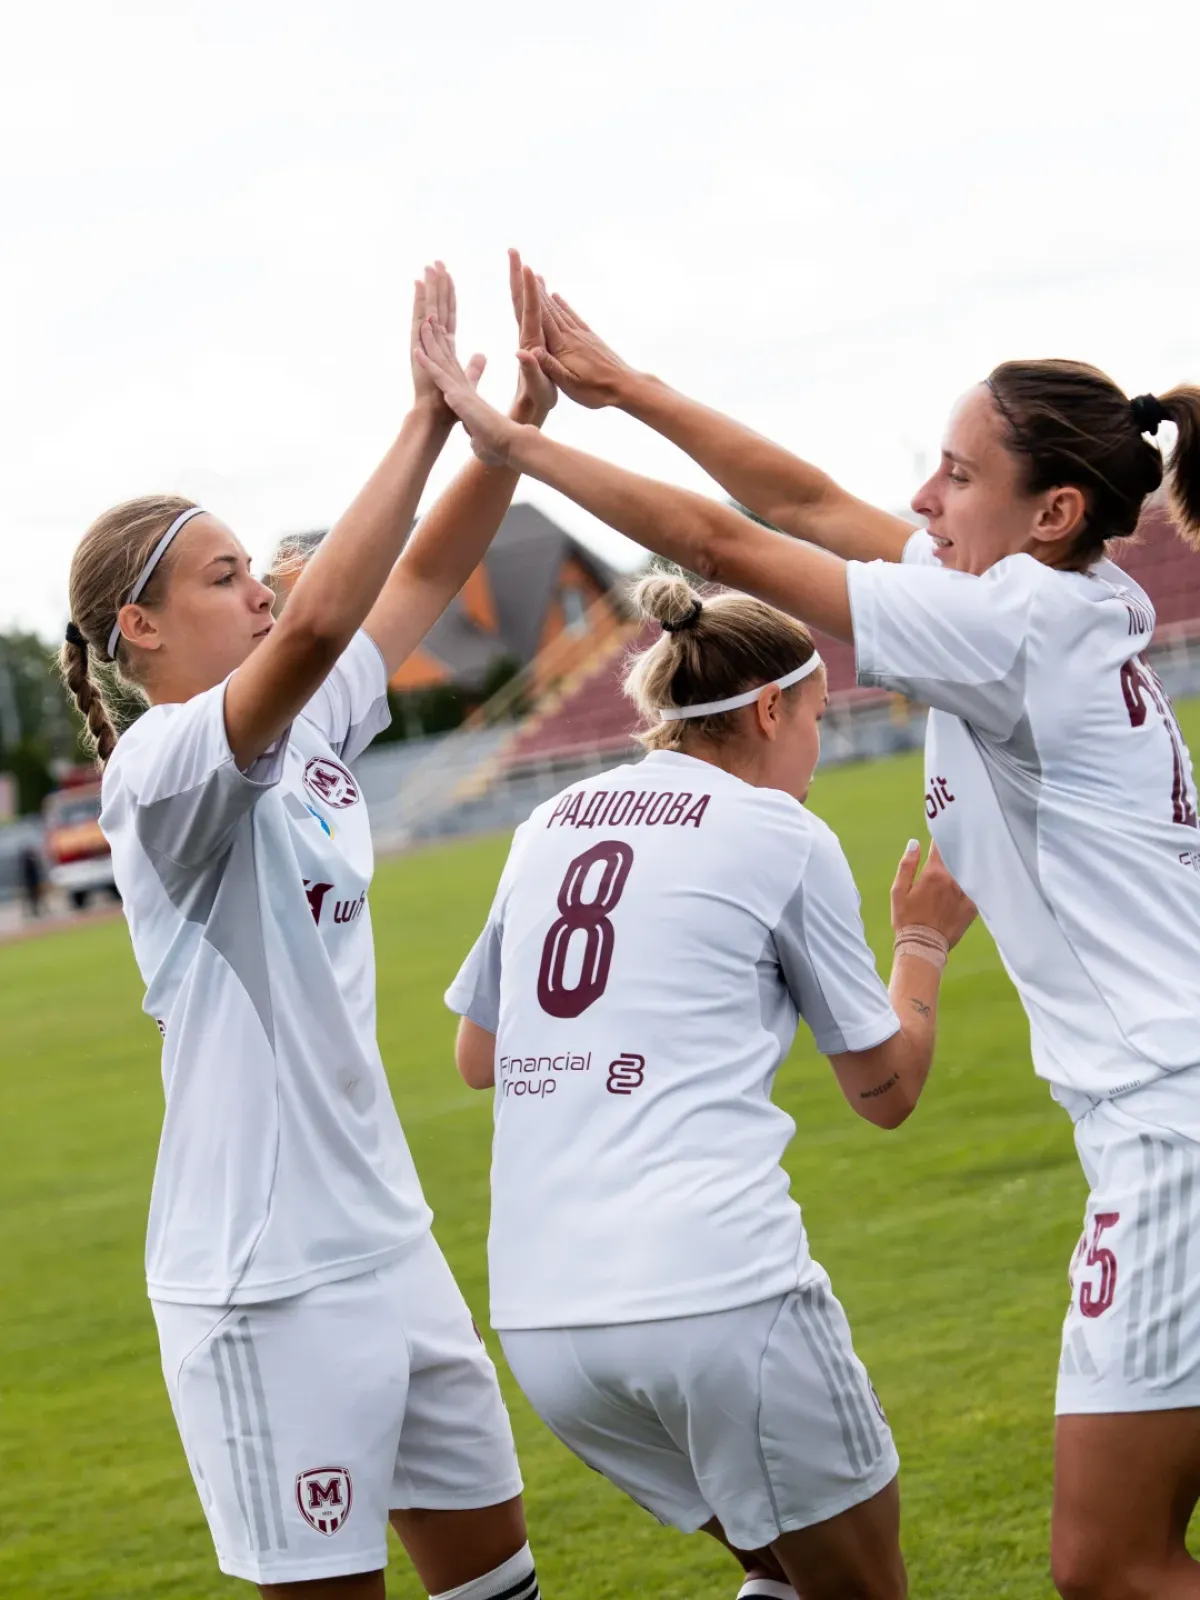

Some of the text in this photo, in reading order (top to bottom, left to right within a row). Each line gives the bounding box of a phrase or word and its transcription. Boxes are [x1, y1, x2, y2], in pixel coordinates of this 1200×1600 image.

[309, 767, 340, 798] M
[547, 790, 711, 829] РАДІОНОВА
[537, 840, 634, 1019] 8
[500, 1051, 592, 1078] Financial
[502, 1078, 557, 1098] roup
[307, 1478, 343, 1509] M
